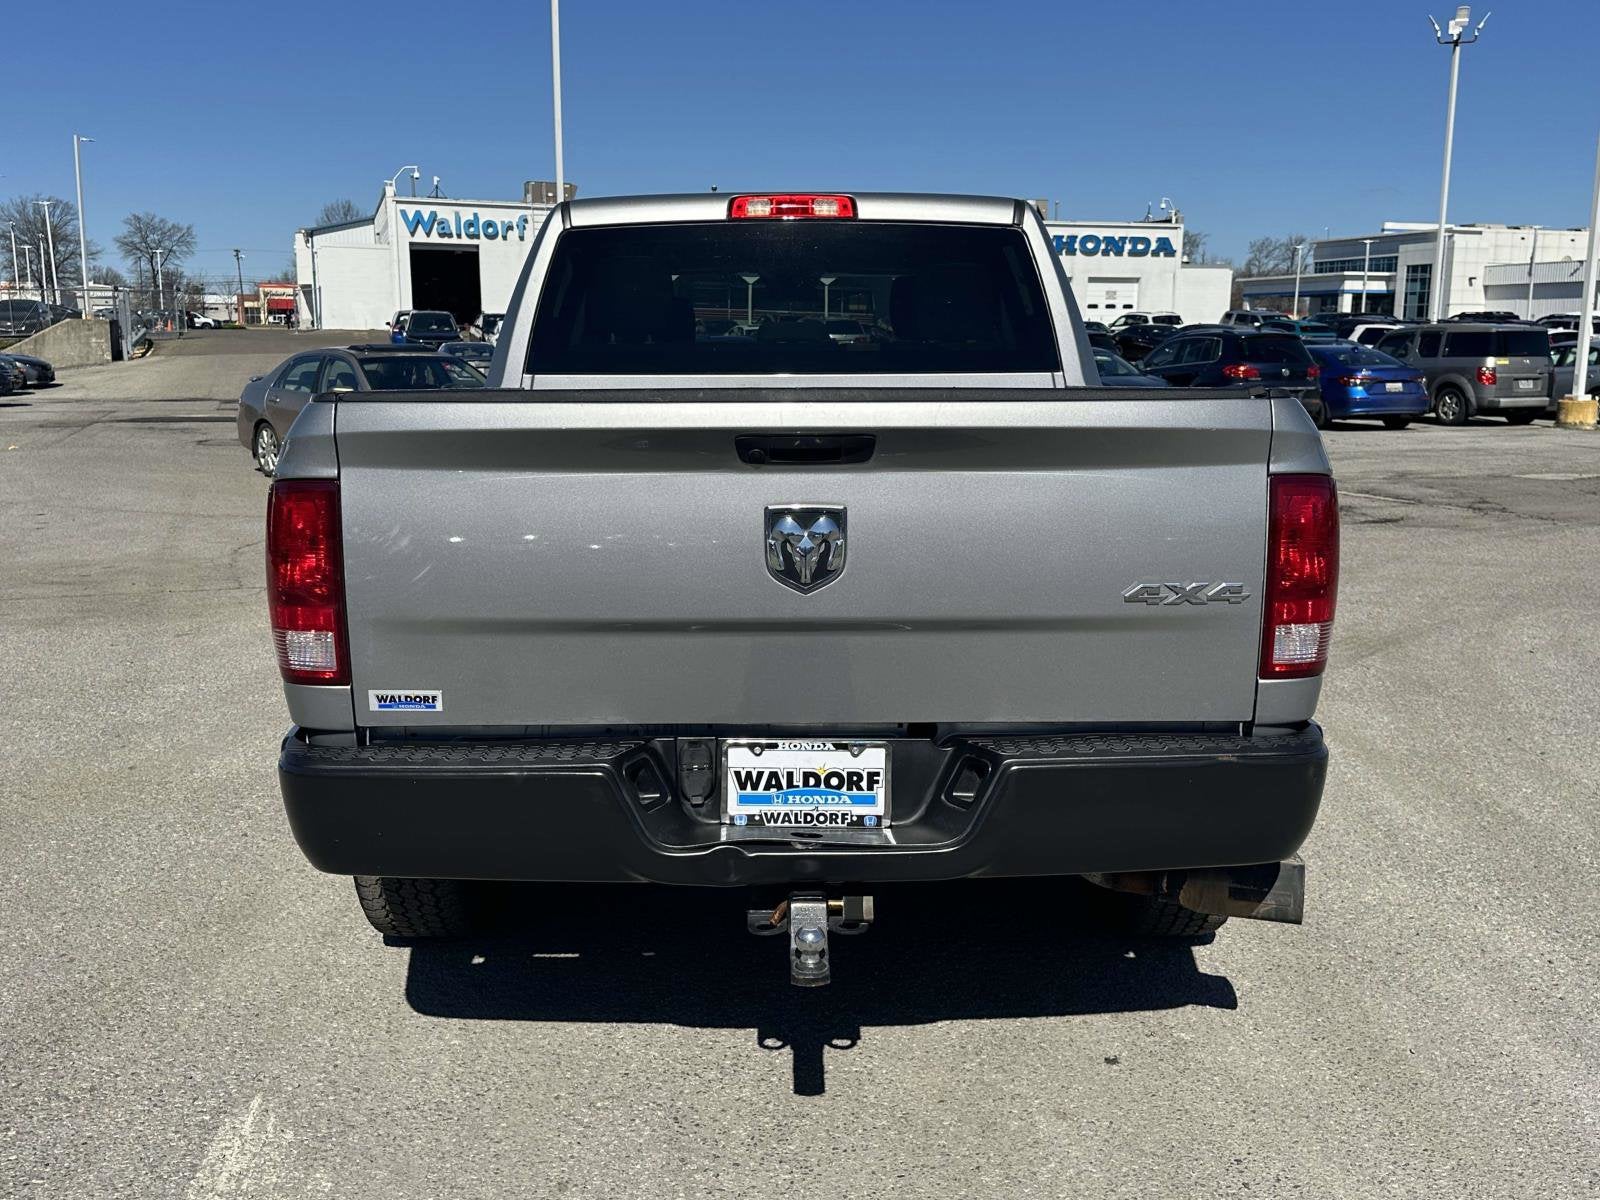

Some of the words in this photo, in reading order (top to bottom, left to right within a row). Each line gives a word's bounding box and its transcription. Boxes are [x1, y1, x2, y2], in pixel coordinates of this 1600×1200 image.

[400, 209, 528, 241] Waldorf
[1052, 234, 1176, 257] HONDA
[376, 694, 438, 704] WALDORF
[776, 741, 836, 751] HONDA
[733, 770, 881, 792] WALDORF
[787, 795, 852, 804] HONDA
[763, 812, 850, 825] WALDORF
